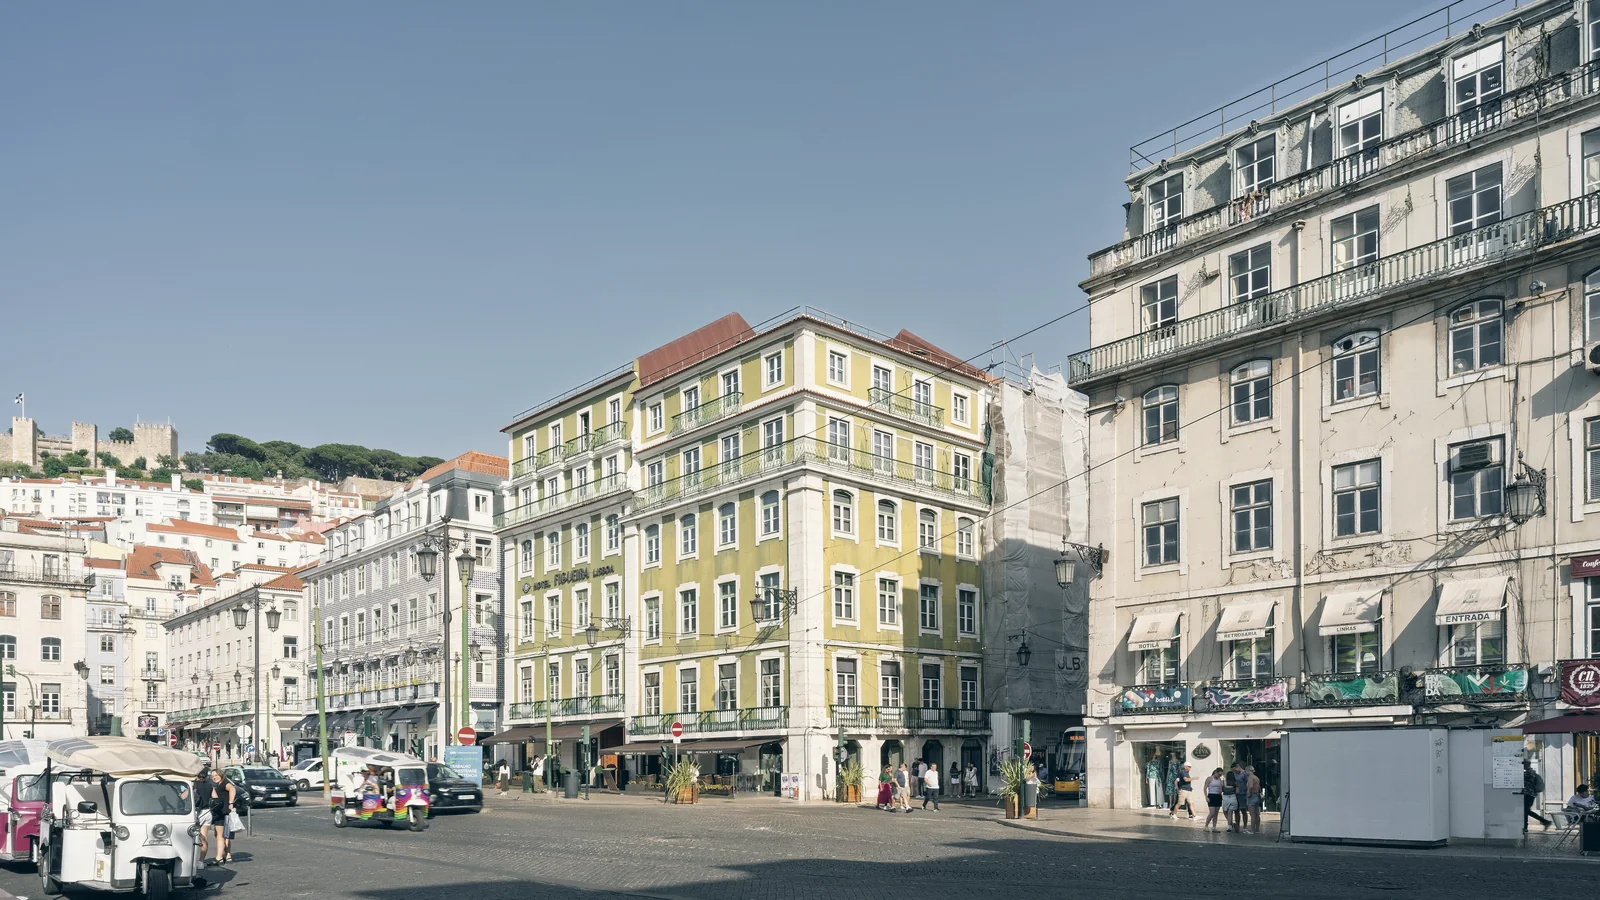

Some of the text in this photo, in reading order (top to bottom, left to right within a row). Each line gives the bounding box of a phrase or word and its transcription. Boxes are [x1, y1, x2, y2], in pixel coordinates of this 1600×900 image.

[533, 564, 615, 591] HOTEL FIGUEIRA LISBOA
[1445, 613, 1490, 623] ENTRADA
[1223, 631, 1258, 639] RETROSARIA
[1057, 656, 1081, 671] JLB
[1425, 674, 1439, 682] EN
[1425, 681, 1443, 689] TRA
[1425, 688, 1440, 697] DA
